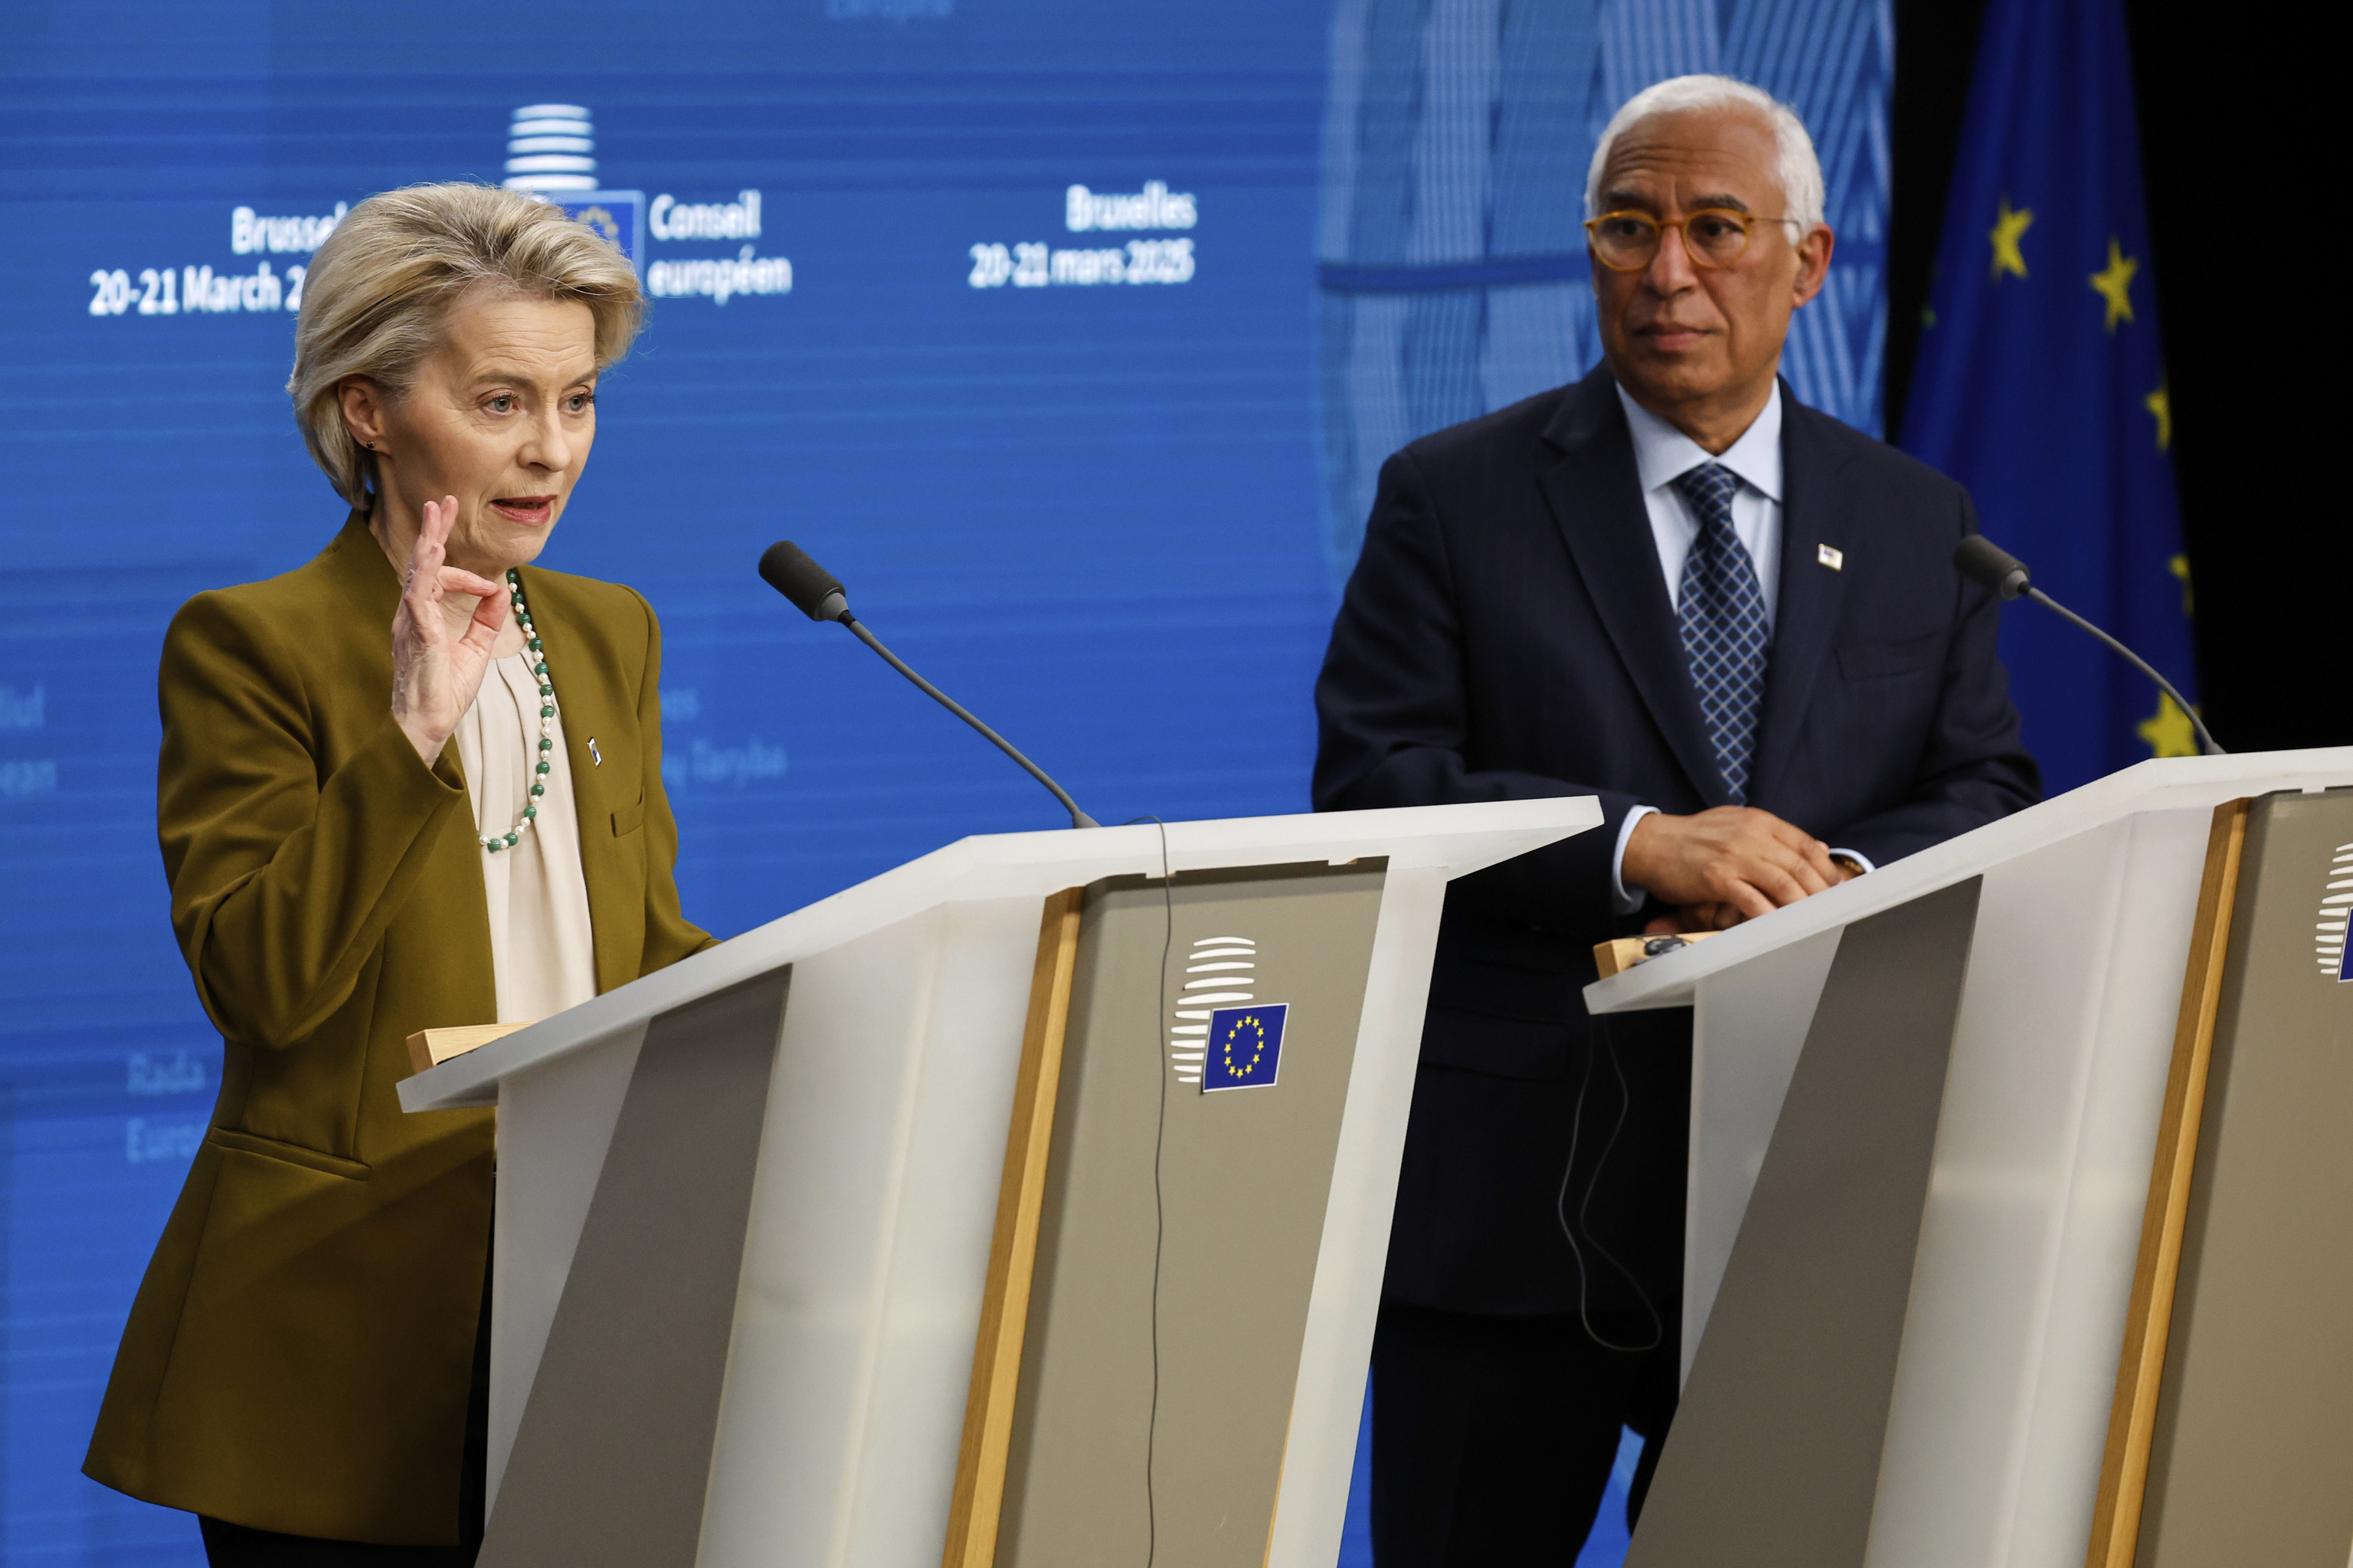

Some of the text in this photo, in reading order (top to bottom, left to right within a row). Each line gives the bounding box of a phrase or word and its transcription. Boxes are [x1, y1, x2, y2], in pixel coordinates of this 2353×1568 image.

[232, 201, 348, 254] Brusse
[650, 189, 761, 240] Conseil
[1066, 180, 1197, 231] Bruxelles
[89, 268, 178, 316] 20-21
[183, 260, 282, 313] March
[648, 244, 792, 306] européen
[968, 237, 1196, 288] 20-21 mars 2025
